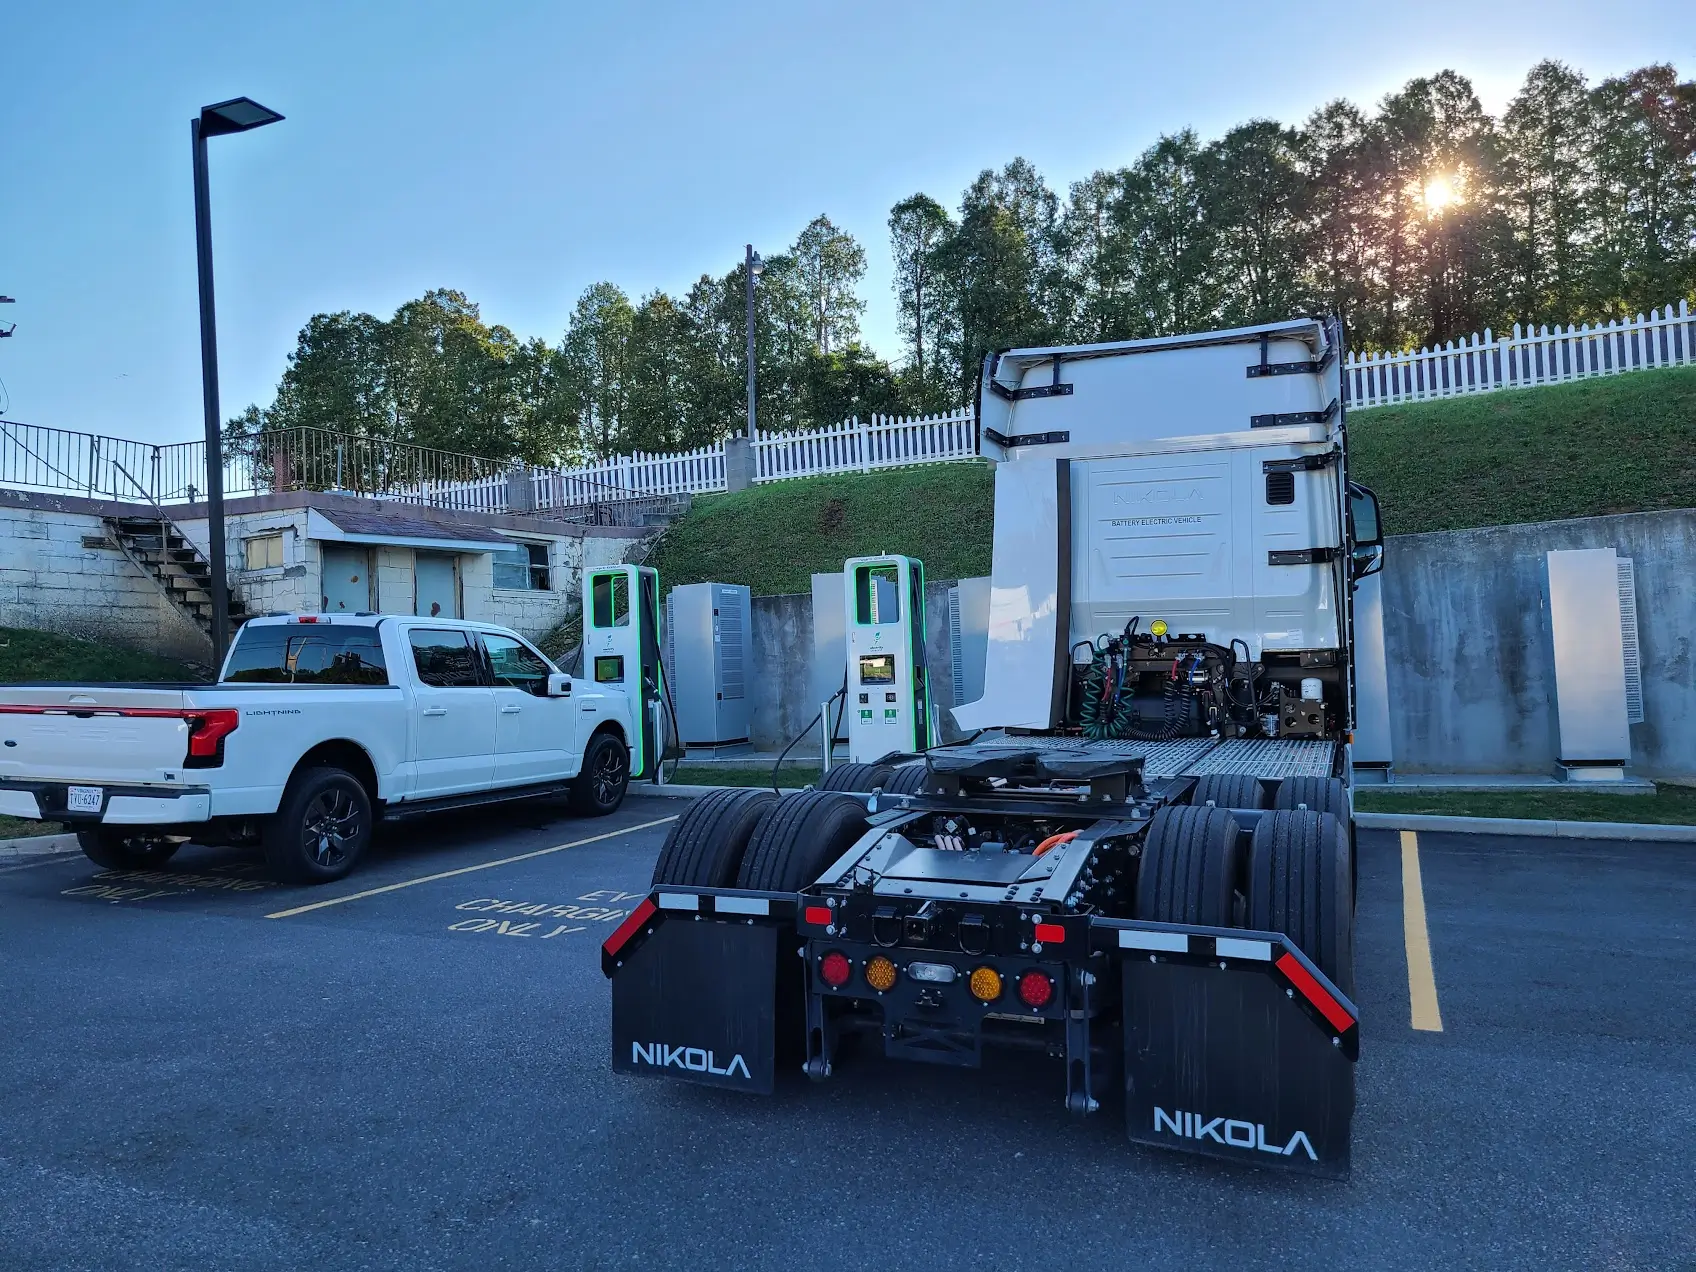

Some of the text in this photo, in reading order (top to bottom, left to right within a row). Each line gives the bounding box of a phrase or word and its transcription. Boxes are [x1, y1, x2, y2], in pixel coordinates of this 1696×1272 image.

[1113, 487, 1204, 505] NIKOLA
[1111, 516, 1202, 527] BATTERY ELECTRIC VEHICLE
[245, 709, 302, 717] LIGHTNING
[576, 890, 647, 903] EV
[455, 898, 631, 922] CHARGI
[448, 918, 588, 939] ONLY
[632, 1041, 752, 1079] NIKOLA
[1153, 1106, 1319, 1161] NIKOLA
